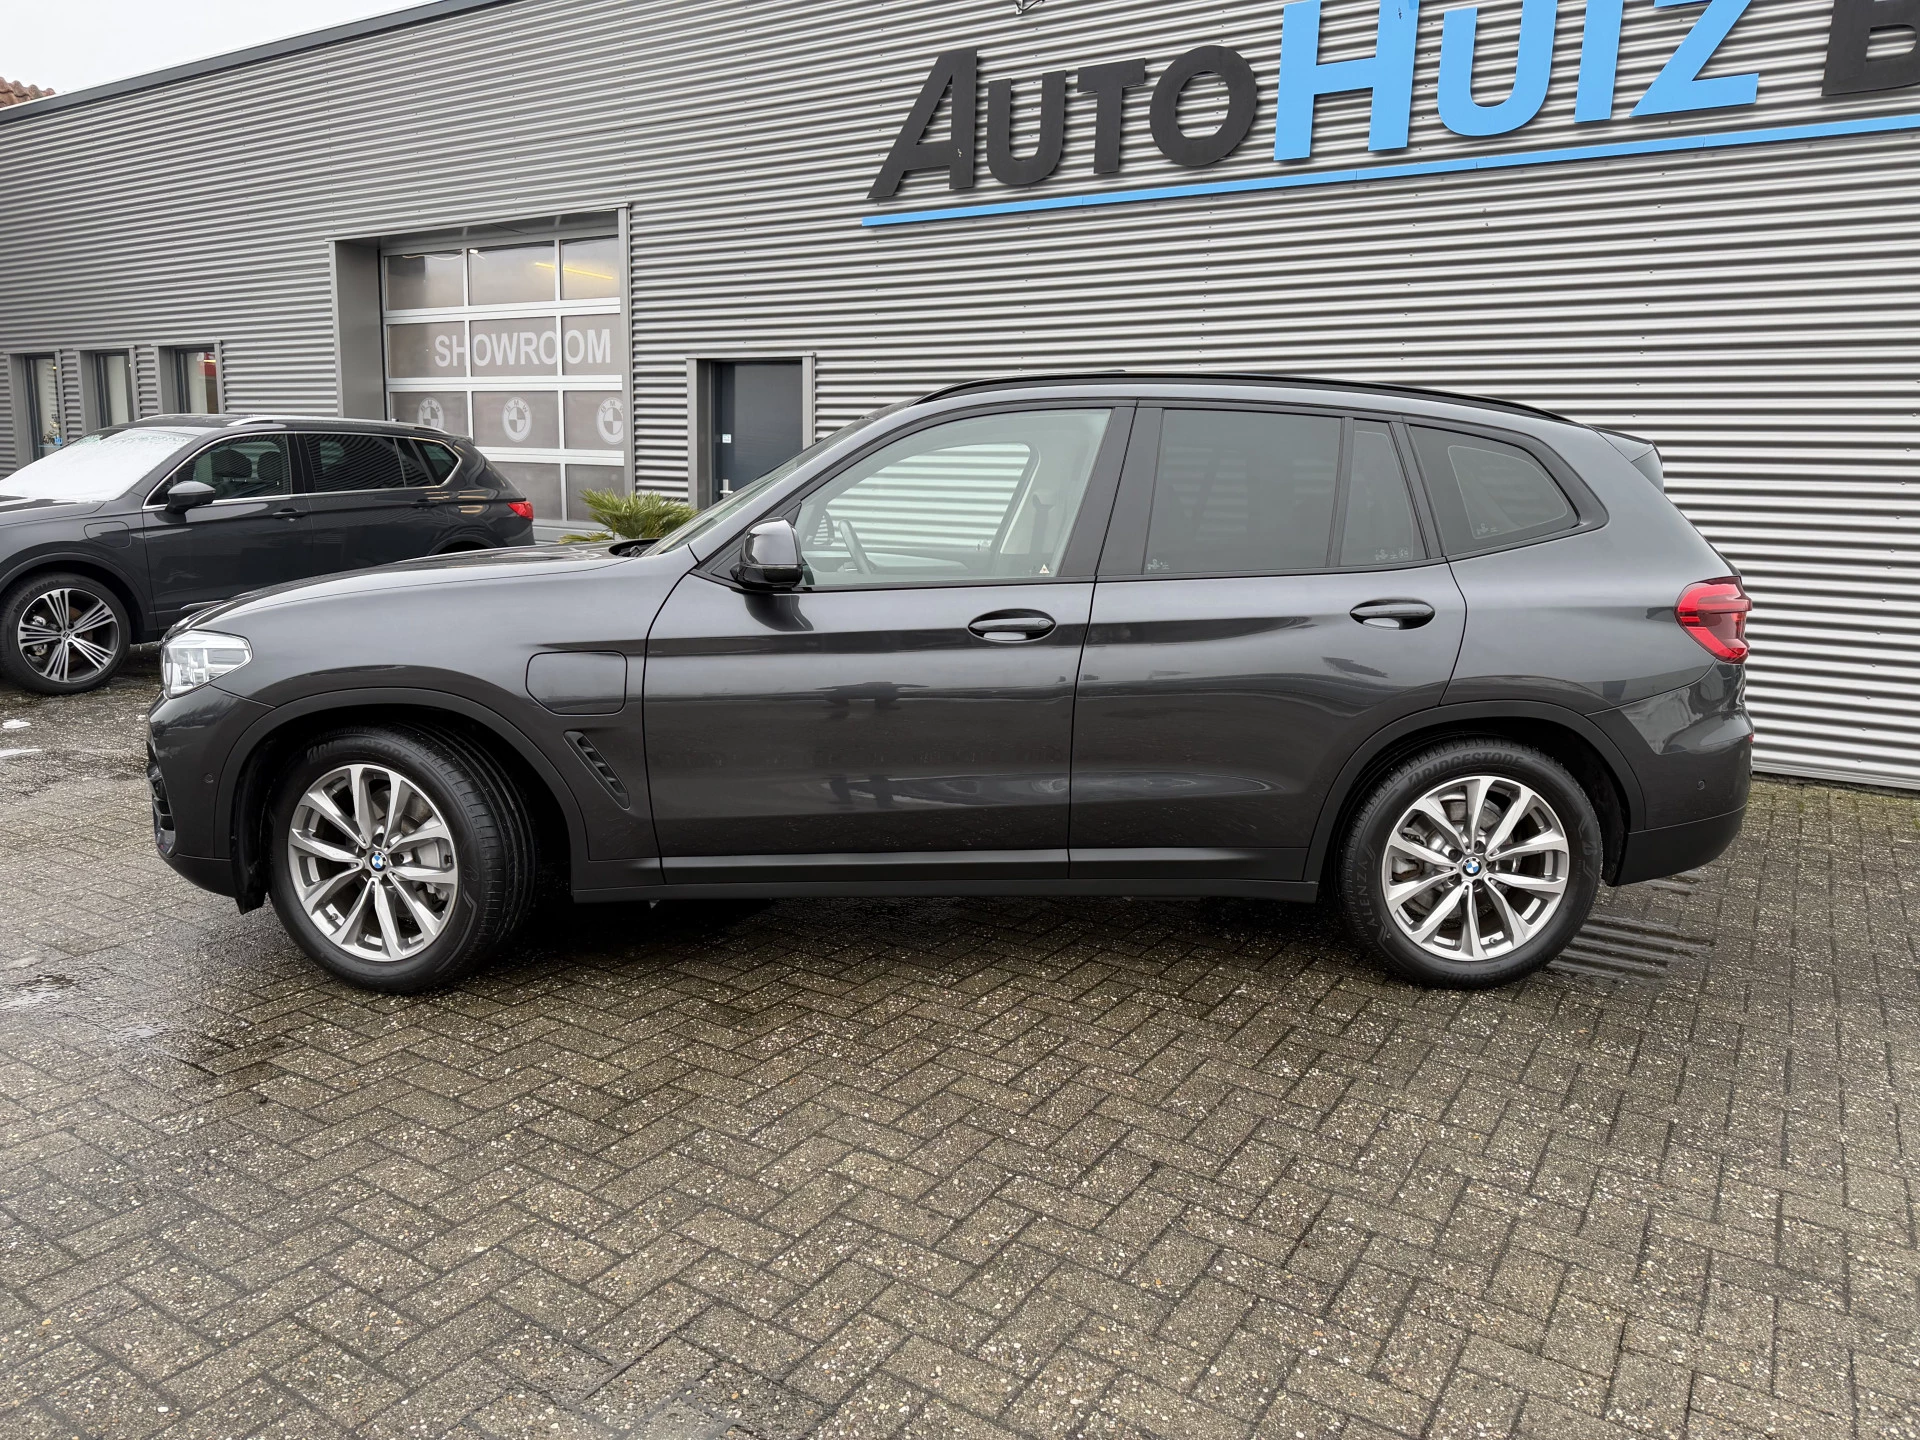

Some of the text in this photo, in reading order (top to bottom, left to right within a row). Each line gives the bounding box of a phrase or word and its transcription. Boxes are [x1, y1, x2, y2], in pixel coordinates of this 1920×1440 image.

[435, 329, 611, 367] SHOWROOM
[1407, 751, 1524, 785] BRIDGESTONE
[1357, 860, 1379, 928] ALENZA
